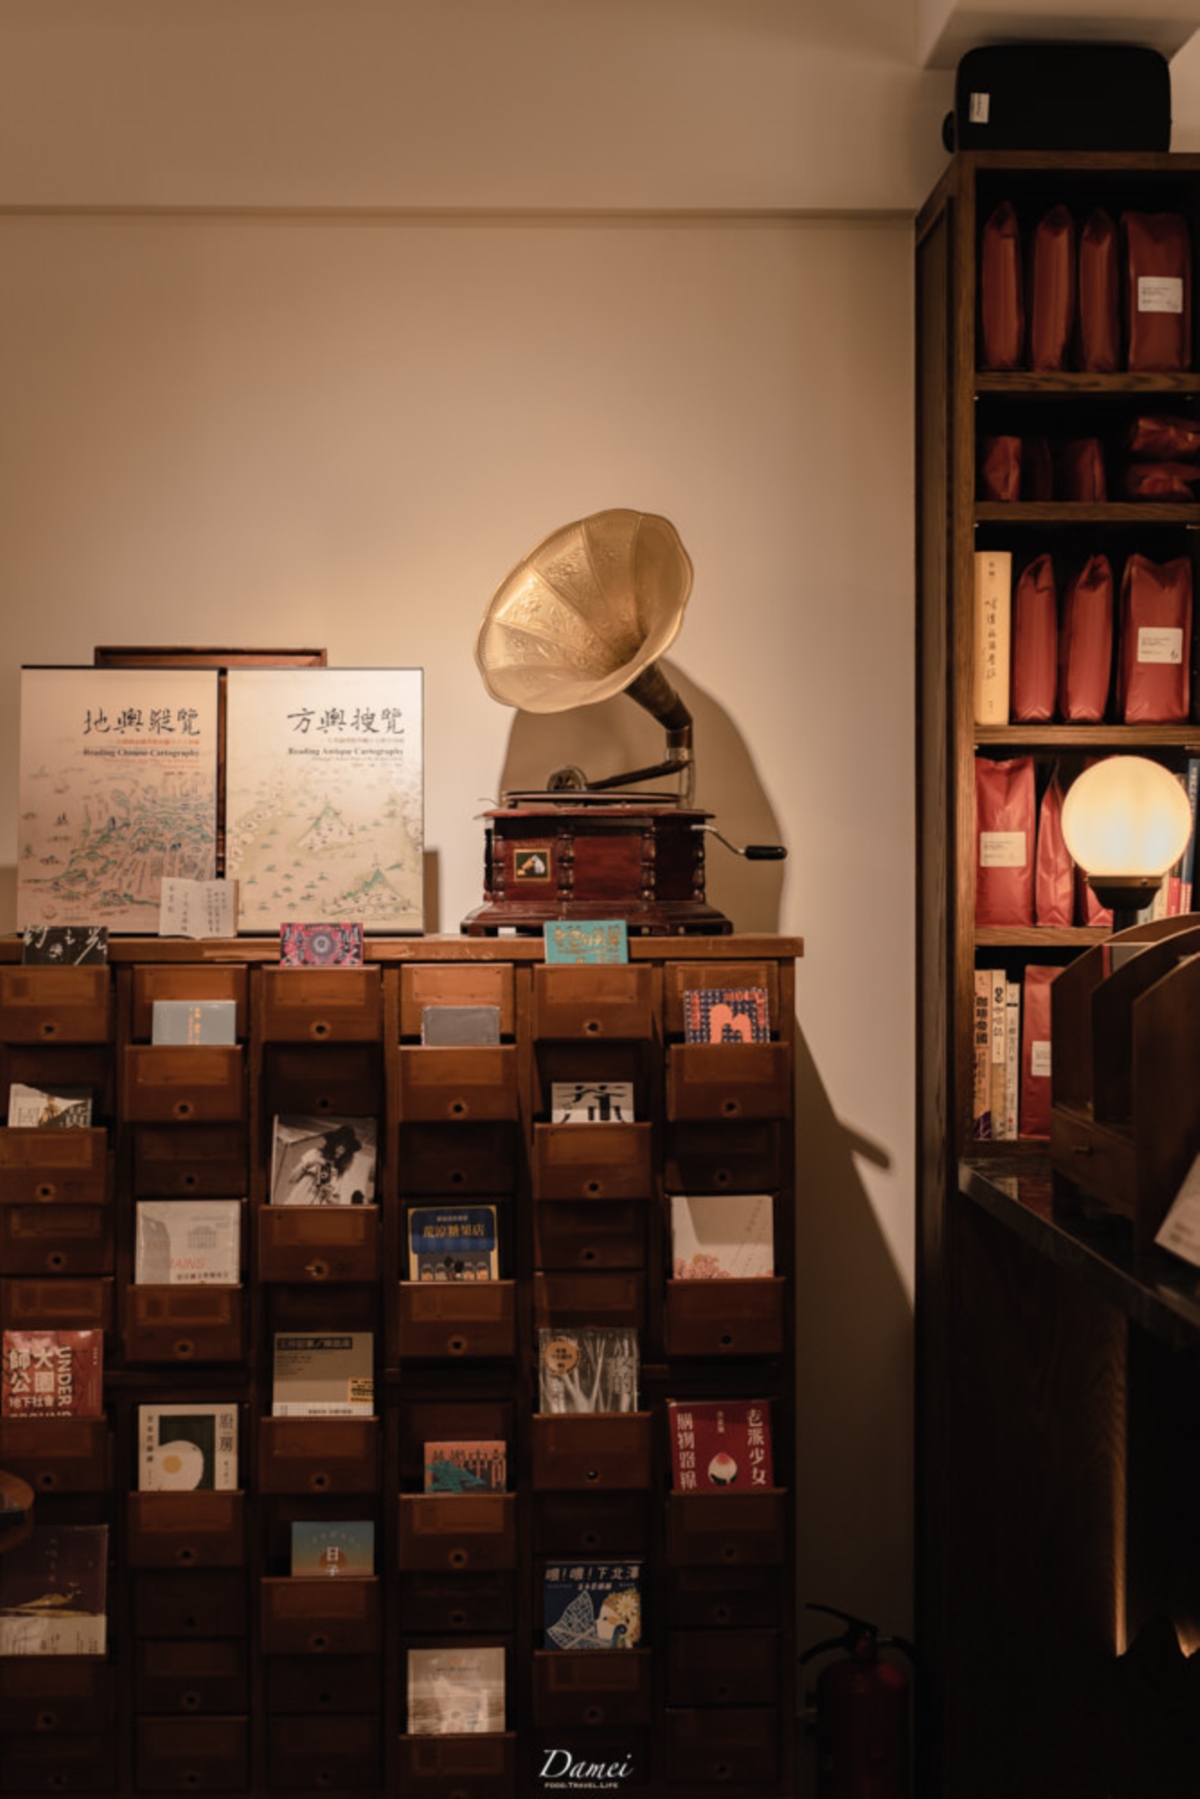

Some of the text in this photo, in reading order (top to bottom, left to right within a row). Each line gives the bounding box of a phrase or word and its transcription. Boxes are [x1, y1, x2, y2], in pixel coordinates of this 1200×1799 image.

[83, 748, 200, 758] Reading Chinese Cartography
[288, 747, 404, 757] Reading Antique Cartography
[747, 1409, 766, 1486] 老派少女
